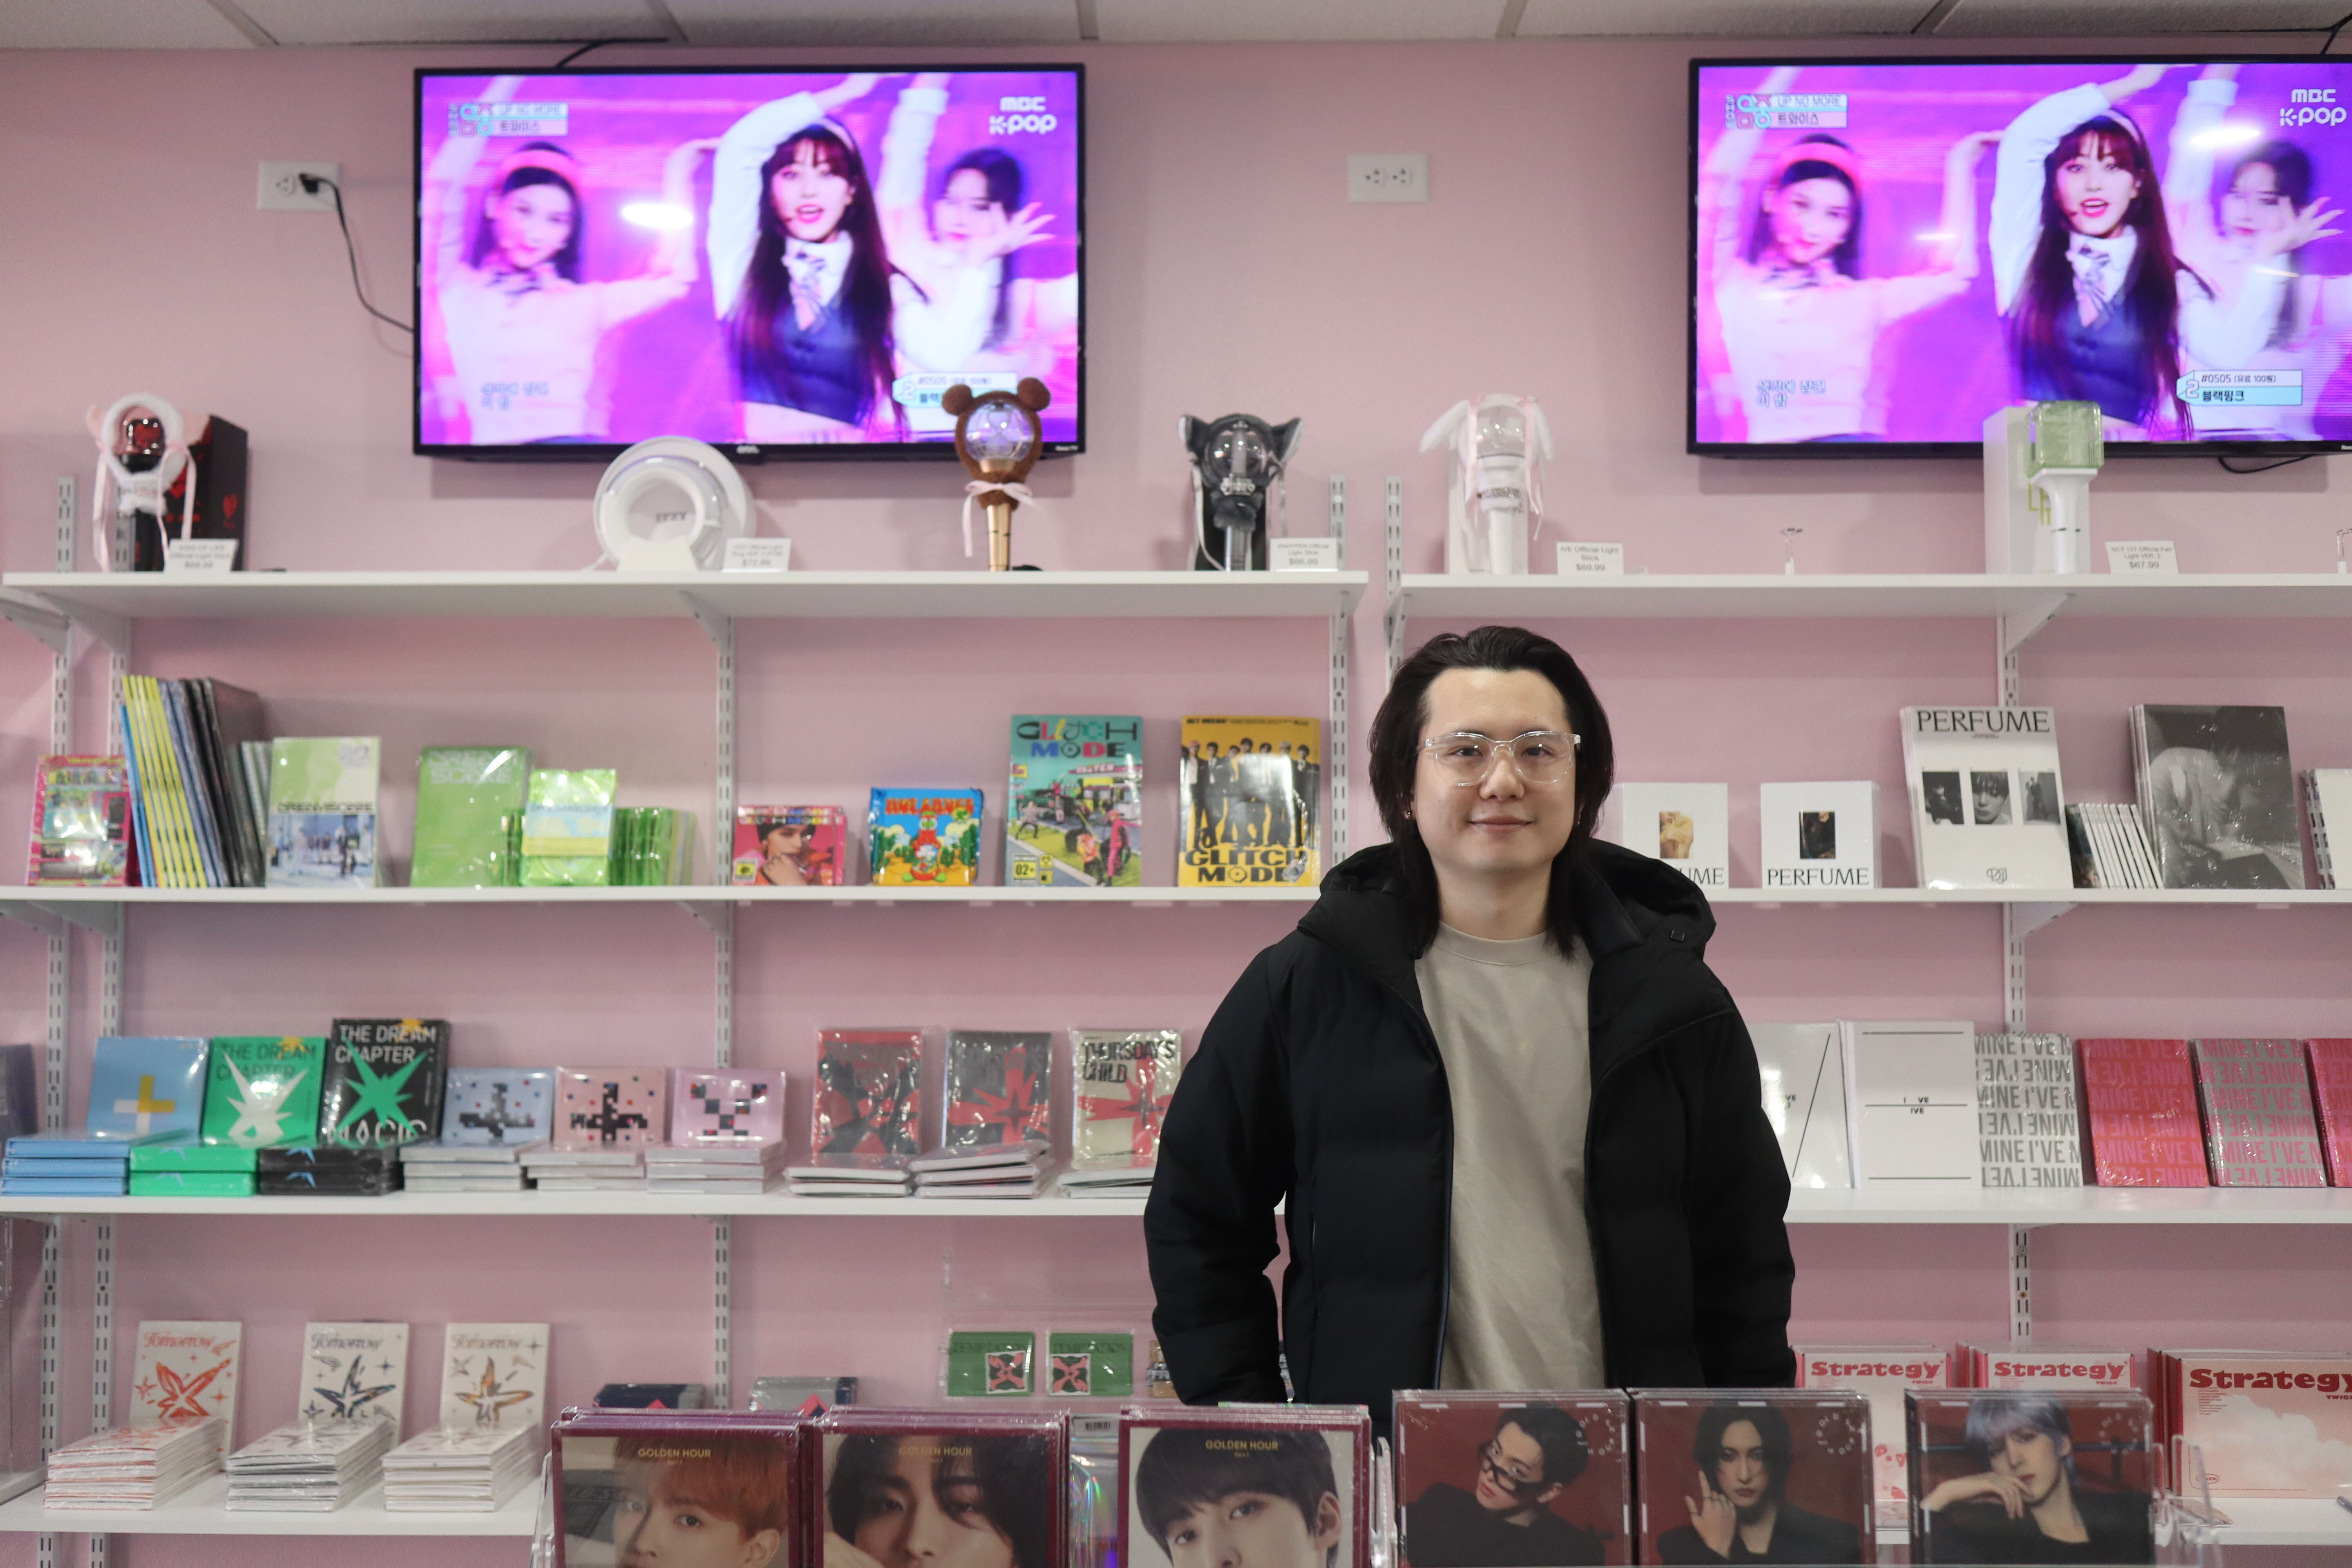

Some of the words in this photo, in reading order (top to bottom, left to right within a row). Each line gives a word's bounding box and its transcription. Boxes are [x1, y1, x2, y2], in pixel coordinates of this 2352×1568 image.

[2292, 89, 2336, 103] MBC
[2201, 374, 2231, 383] #0505
[2234, 374, 2250, 383] (유료
[2185, 379, 2199, 399] 2
[2203, 390, 2244, 401] 블랙핑크
[1016, 718, 1138, 741] GLITCH
[1916, 710, 2050, 733] PERFUME
[1031, 741, 1125, 759] MODE
[1185, 849, 1306, 866] GLITCH
[1768, 868, 1869, 885] PERFUME
[339, 1025, 372, 1042] THE
[376, 1025, 436, 1043] DREAM
[1081, 1060, 1127, 1083] CHILD
[2022, 1059, 2071, 1082] MINE
[1976, 1086, 2021, 1108] MINE
[2028, 1112, 2076, 1136] MINE
[1980, 1140, 2025, 1163] MINE
[2221, 1141, 2268, 1164] MINE
[2031, 1167, 2080, 1187] MINE
[143, 1331, 215, 1349] Tomorrow
[312, 1332, 384, 1351] Tomorrow
[451, 1332, 524, 1350] Tomorrow
[1811, 1361, 1941, 1379] Strategy
[1994, 1361, 2125, 1379] Strategy
[638, 1448, 680, 1458] GOLDEN
[682, 1448, 711, 1458] HOUR
[898, 1446, 941, 1456] GOLDEN
[944, 1446, 973, 1456] HOUR
[1205, 1439, 1247, 1450] GOLDEN
[1250, 1440, 1278, 1450] HOUR
